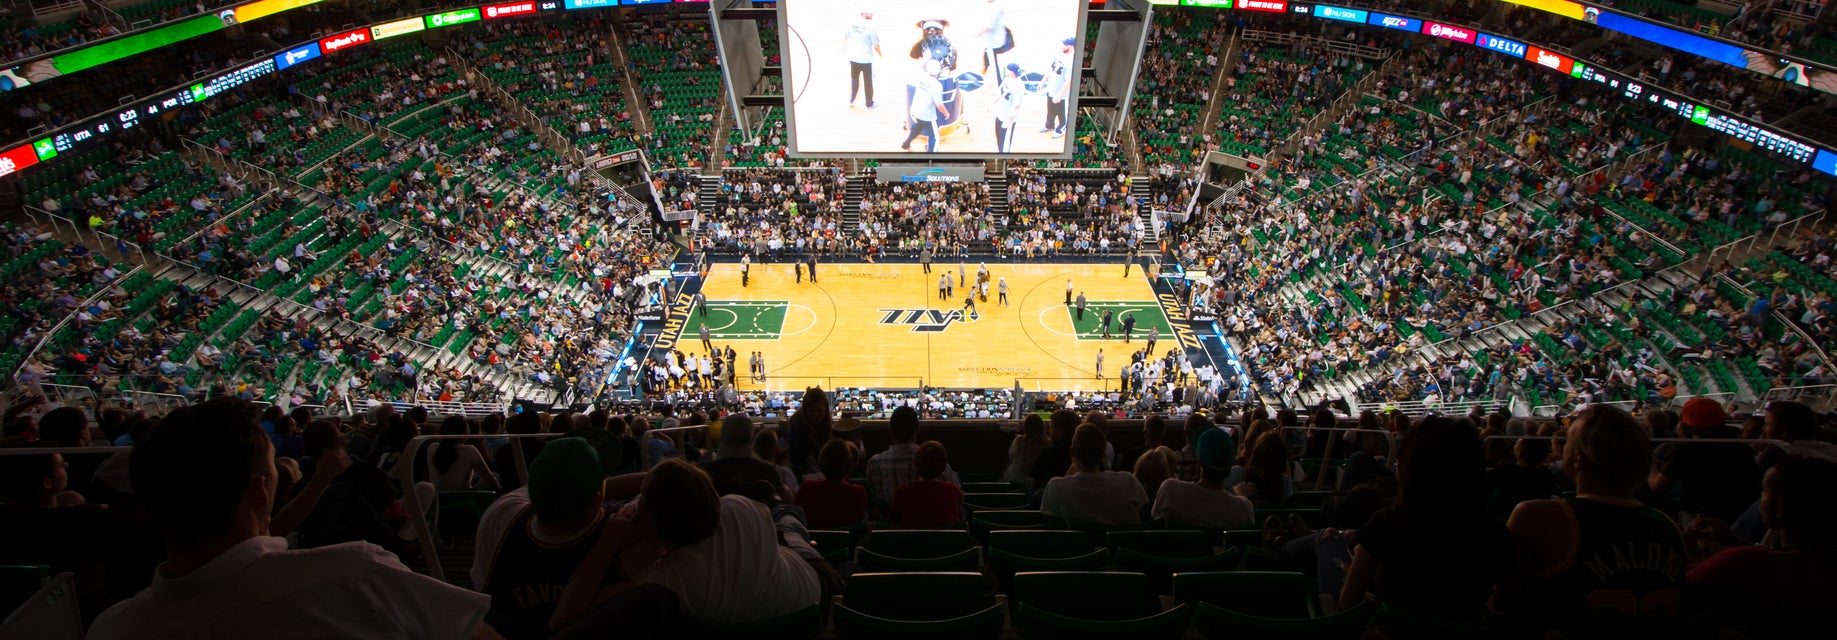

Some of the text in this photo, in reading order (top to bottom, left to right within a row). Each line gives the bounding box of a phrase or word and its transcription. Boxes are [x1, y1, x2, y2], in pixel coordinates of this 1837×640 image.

[1332, 9, 1356, 19] NU SKIN
[1489, 38, 1524, 55] DELTA
[1594, 73, 1606, 83] UTA
[1610, 79, 1619, 88] 61
[1649, 94, 1659, 103] 44
[1663, 98, 1678, 110] POR
[74, 130, 91, 141] UTA
[98, 123, 110, 133] 61
[119, 109, 137, 123] 6:23
[148, 105, 158, 114] 44
[163, 98, 177, 109] POR
[655, 317, 684, 349] UTAH
[671, 293, 696, 317] JAZZ
[1158, 293, 1186, 321] UTAH
[1170, 321, 1202, 349] JAZZ
[1582, 540, 1682, 584] MALON
